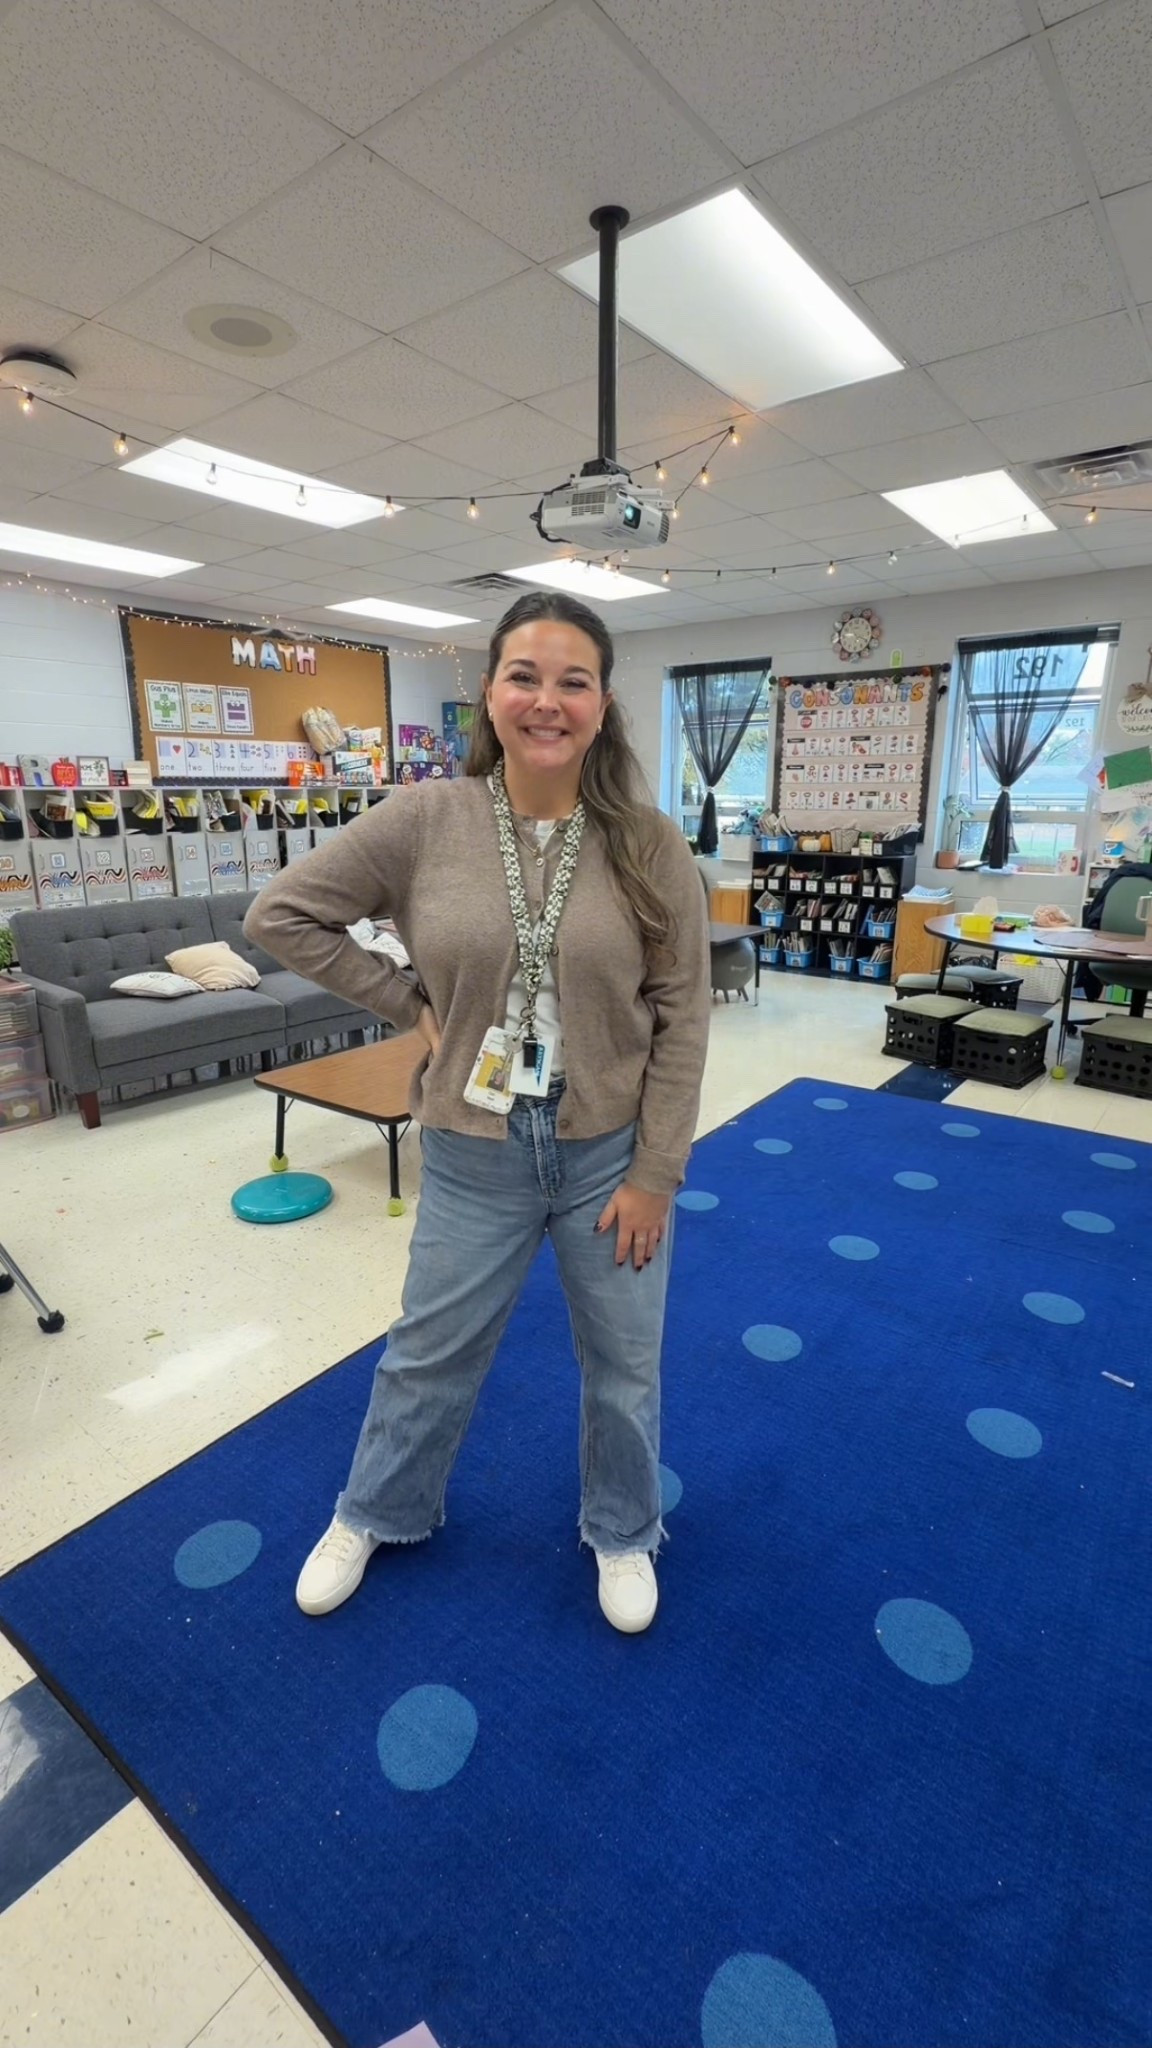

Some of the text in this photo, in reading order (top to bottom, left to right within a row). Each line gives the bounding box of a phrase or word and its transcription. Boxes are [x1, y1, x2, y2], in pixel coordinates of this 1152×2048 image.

[230, 636, 316, 676] MATH
[790, 682, 925, 708] CONSONANTS
[186, 741, 197, 758] 2
[214, 742, 222, 759] 3
[239, 743, 251, 758] 4
[263, 744, 271, 759] 5
[160, 764, 175, 772] one
[188, 763, 203, 772] two
[215, 763, 235, 772] three
[240, 763, 255, 772] four
[264, 763, 277, 772] five
